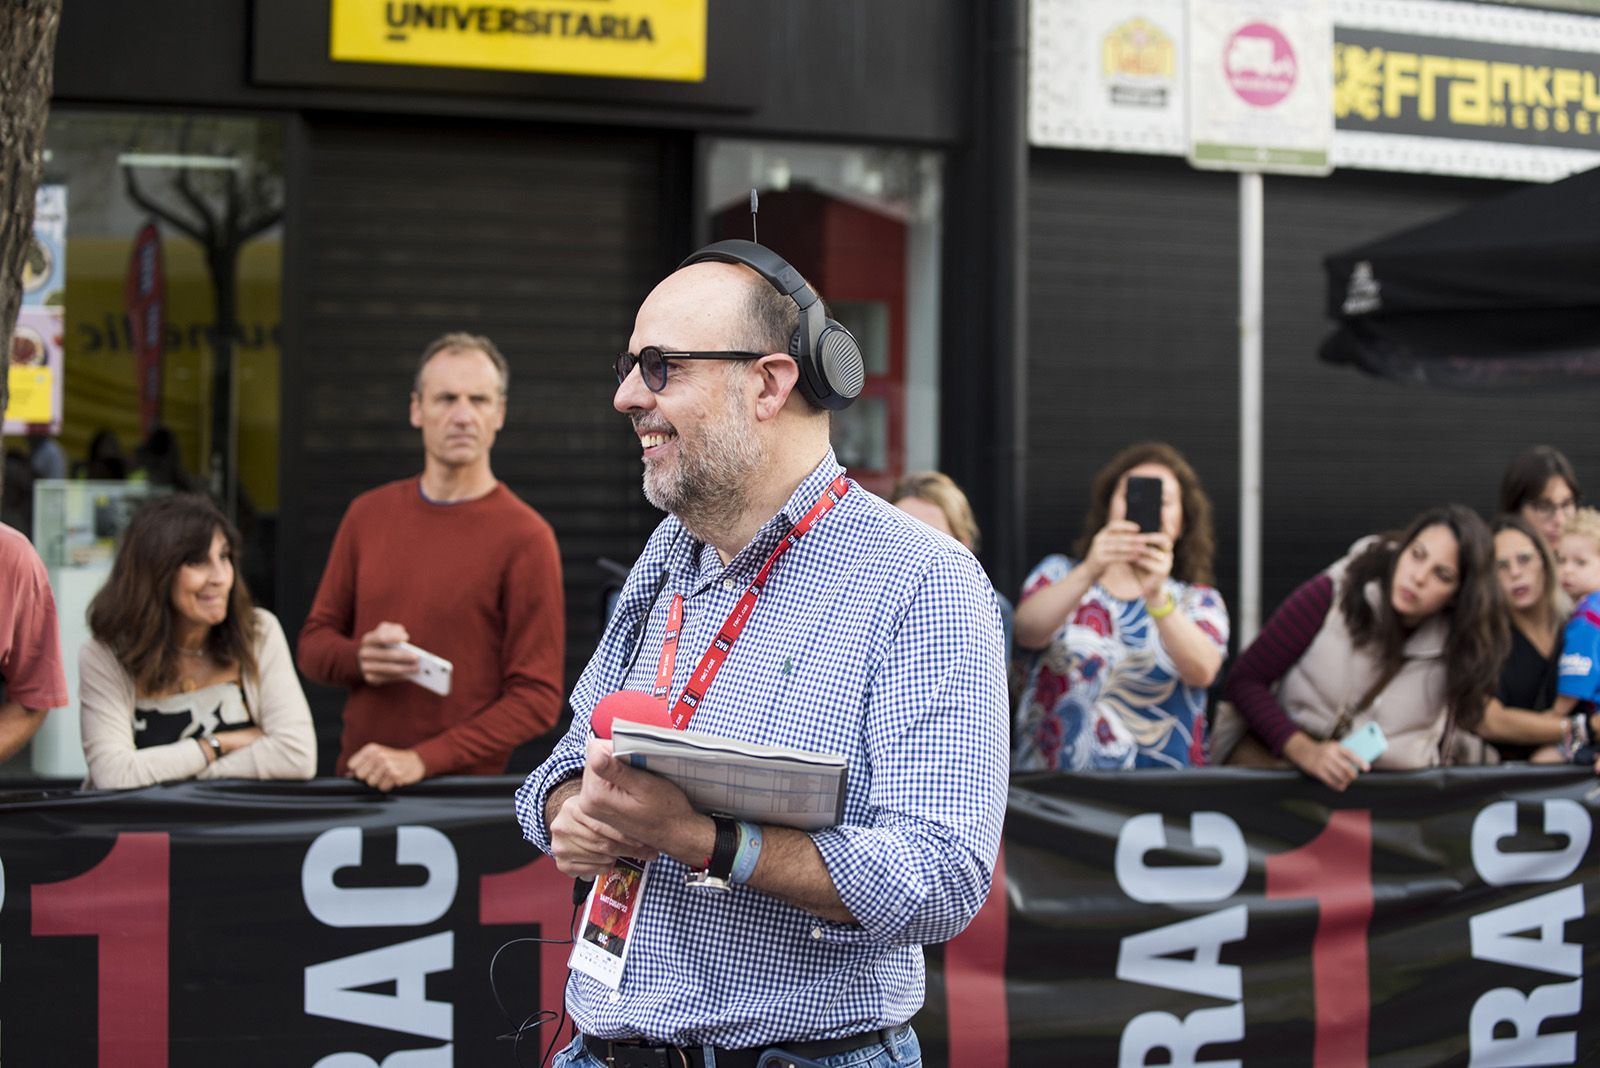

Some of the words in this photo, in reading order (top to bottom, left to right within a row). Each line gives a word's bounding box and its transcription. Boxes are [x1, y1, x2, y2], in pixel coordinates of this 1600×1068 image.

[385, 1, 655, 42] UNIVERSITARIA
[732, 604, 749, 628] rac1.cat
[714, 639, 730, 652] RAC
[655, 685, 668, 695] RAC
[699, 658, 716, 683] rac1.cat
[682, 694, 698, 708] RAC
[31, 832, 169, 1068] 1
[301, 825, 458, 1068] AC
[1114, 812, 1248, 1068] RAC
[1265, 810, 1372, 1068] 1
[1469, 799, 1592, 1068] RAC
